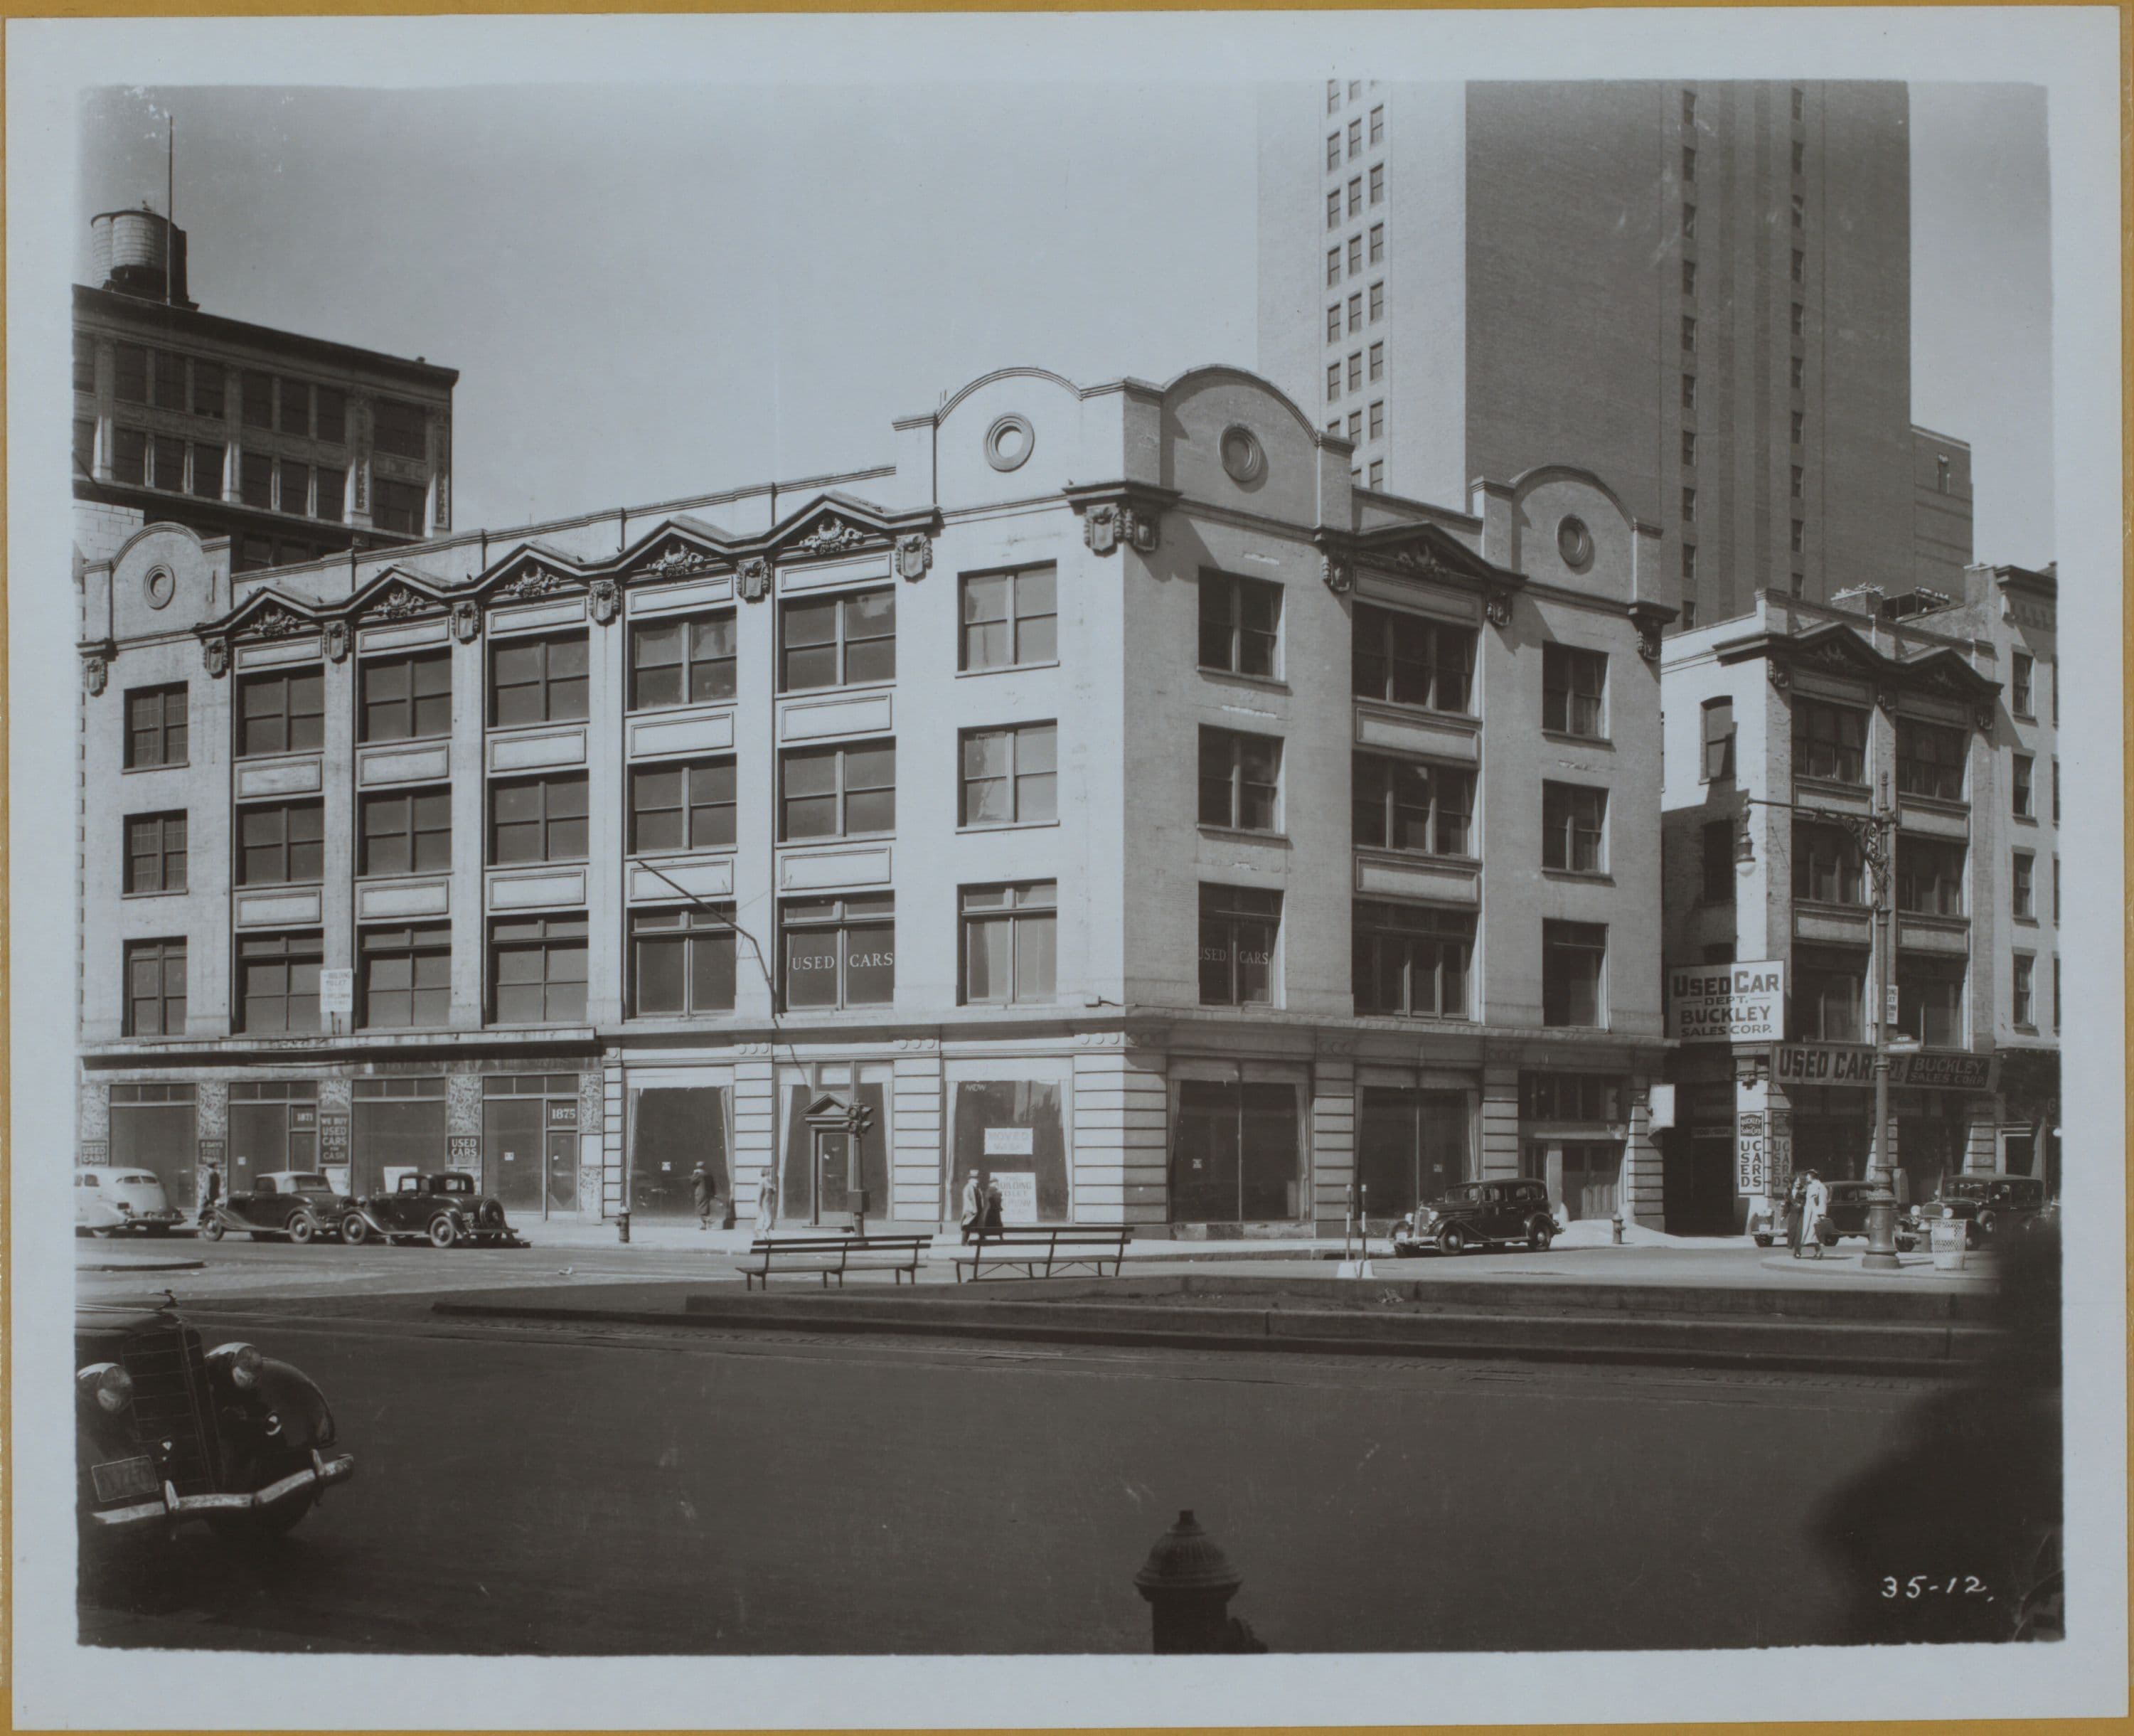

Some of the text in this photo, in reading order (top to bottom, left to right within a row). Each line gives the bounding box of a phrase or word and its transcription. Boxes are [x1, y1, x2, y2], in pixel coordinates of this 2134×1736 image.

[792, 952, 894, 970] USED CARS
[1239, 950, 1269, 965] CARS
[1672, 970, 1780, 997] USED CAR
[1704, 996, 1749, 1006] DEPT.
[1680, 1006, 1771, 1025] BUCKLEY
[1680, 1023, 1773, 1038] SALES CORP.
[1779, 1048, 1829, 1077] USED
[1914, 1057, 1984, 1075] BUCKLEY
[1910, 1071, 1951, 1082] SALES
[551, 1108, 576, 1119] 1875
[322, 1127, 347, 1136] USED
[322, 1136, 348, 1146] CARS
[452, 1139, 477, 1147] USED
[323, 1151, 346, 1160] CASH
[451, 1147, 477, 1157] CARS
[82, 1154, 106, 1163] CARS
